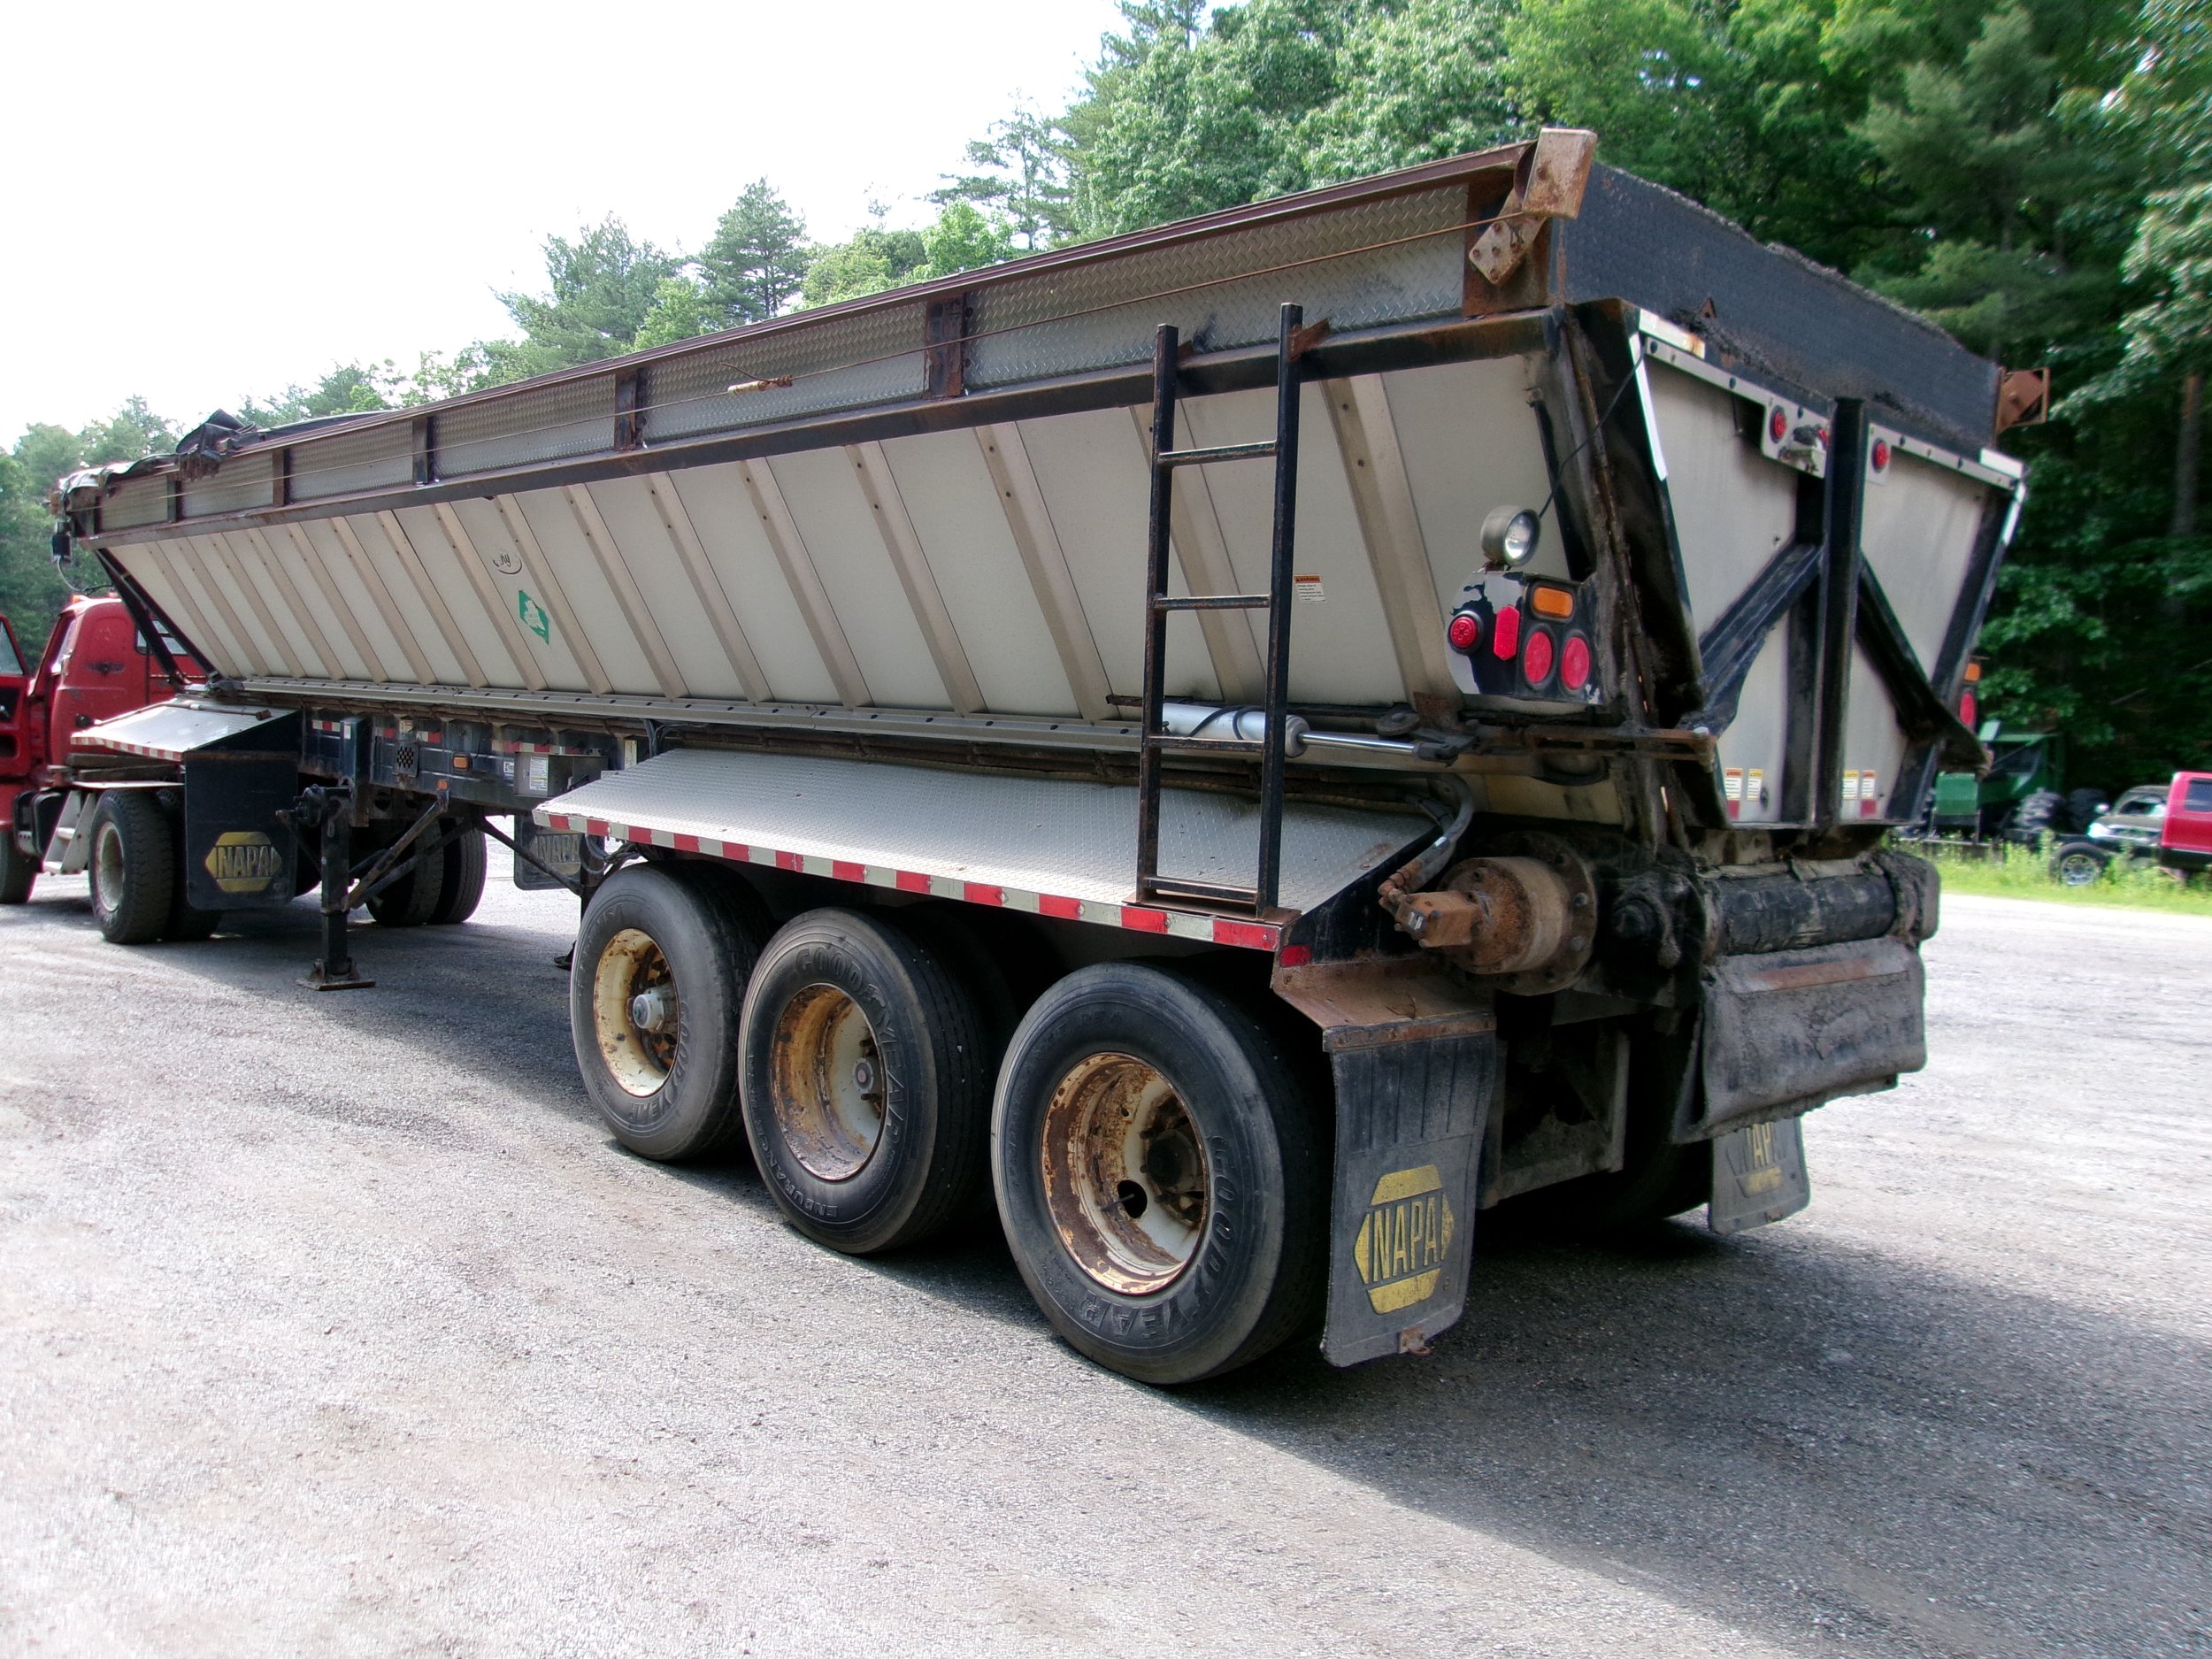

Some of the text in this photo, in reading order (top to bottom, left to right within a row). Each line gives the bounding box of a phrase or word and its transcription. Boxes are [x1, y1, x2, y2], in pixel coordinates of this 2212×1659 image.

[218, 846, 269, 879] NAPA
[1077, 1134, 1236, 1339] GOODYEAR
[1372, 1195, 1439, 1283] NAPA
